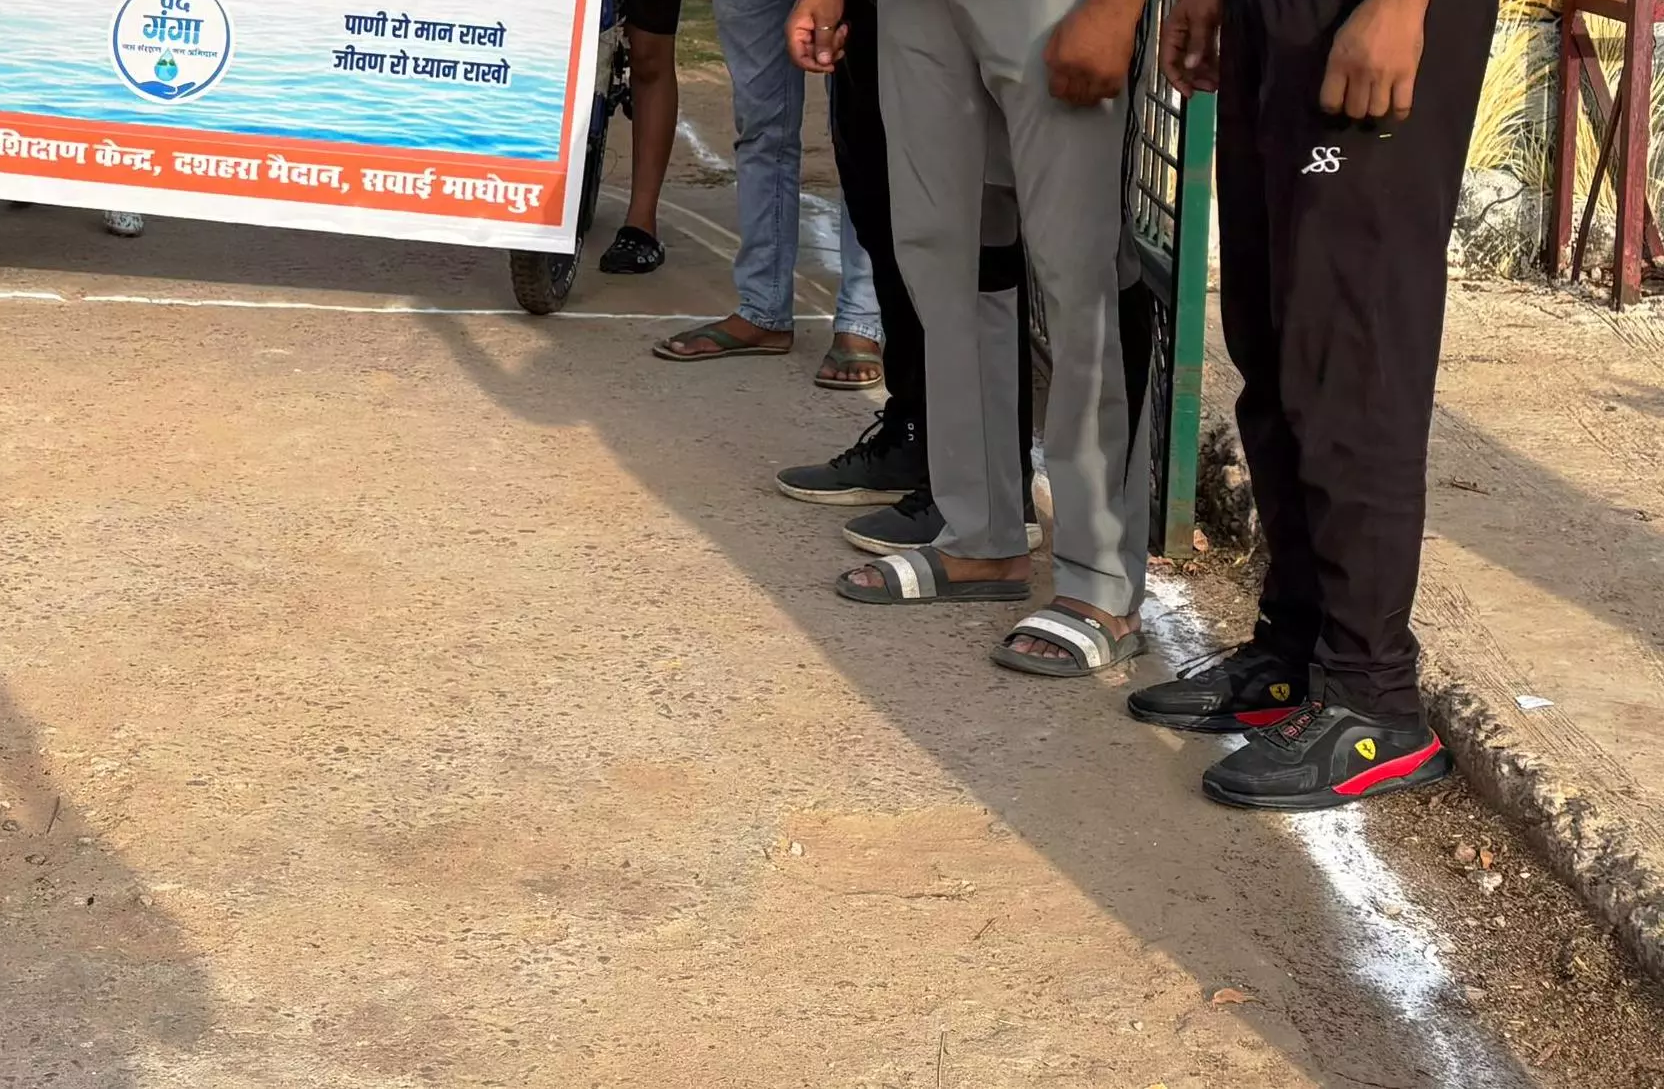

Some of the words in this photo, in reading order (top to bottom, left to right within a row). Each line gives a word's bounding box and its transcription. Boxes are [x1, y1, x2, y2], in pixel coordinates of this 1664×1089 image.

[143, 9, 204, 45] गंगा
[344, 11, 388, 37] पाणी
[391, 13, 411, 39] रो
[414, 20, 456, 43] मान
[459, 21, 507, 48] राखो
[332, 44, 387, 73] जीवण
[390, 49, 409, 76] रो
[413, 56, 460, 80] ध्यान
[463, 58, 511, 85] राखो
[93, 138, 163, 177] केन्द्र,
[172, 151, 262, 181] दशहरा
[266, 153, 350, 194] मैदान,
[360, 167, 437, 200] सवाई
